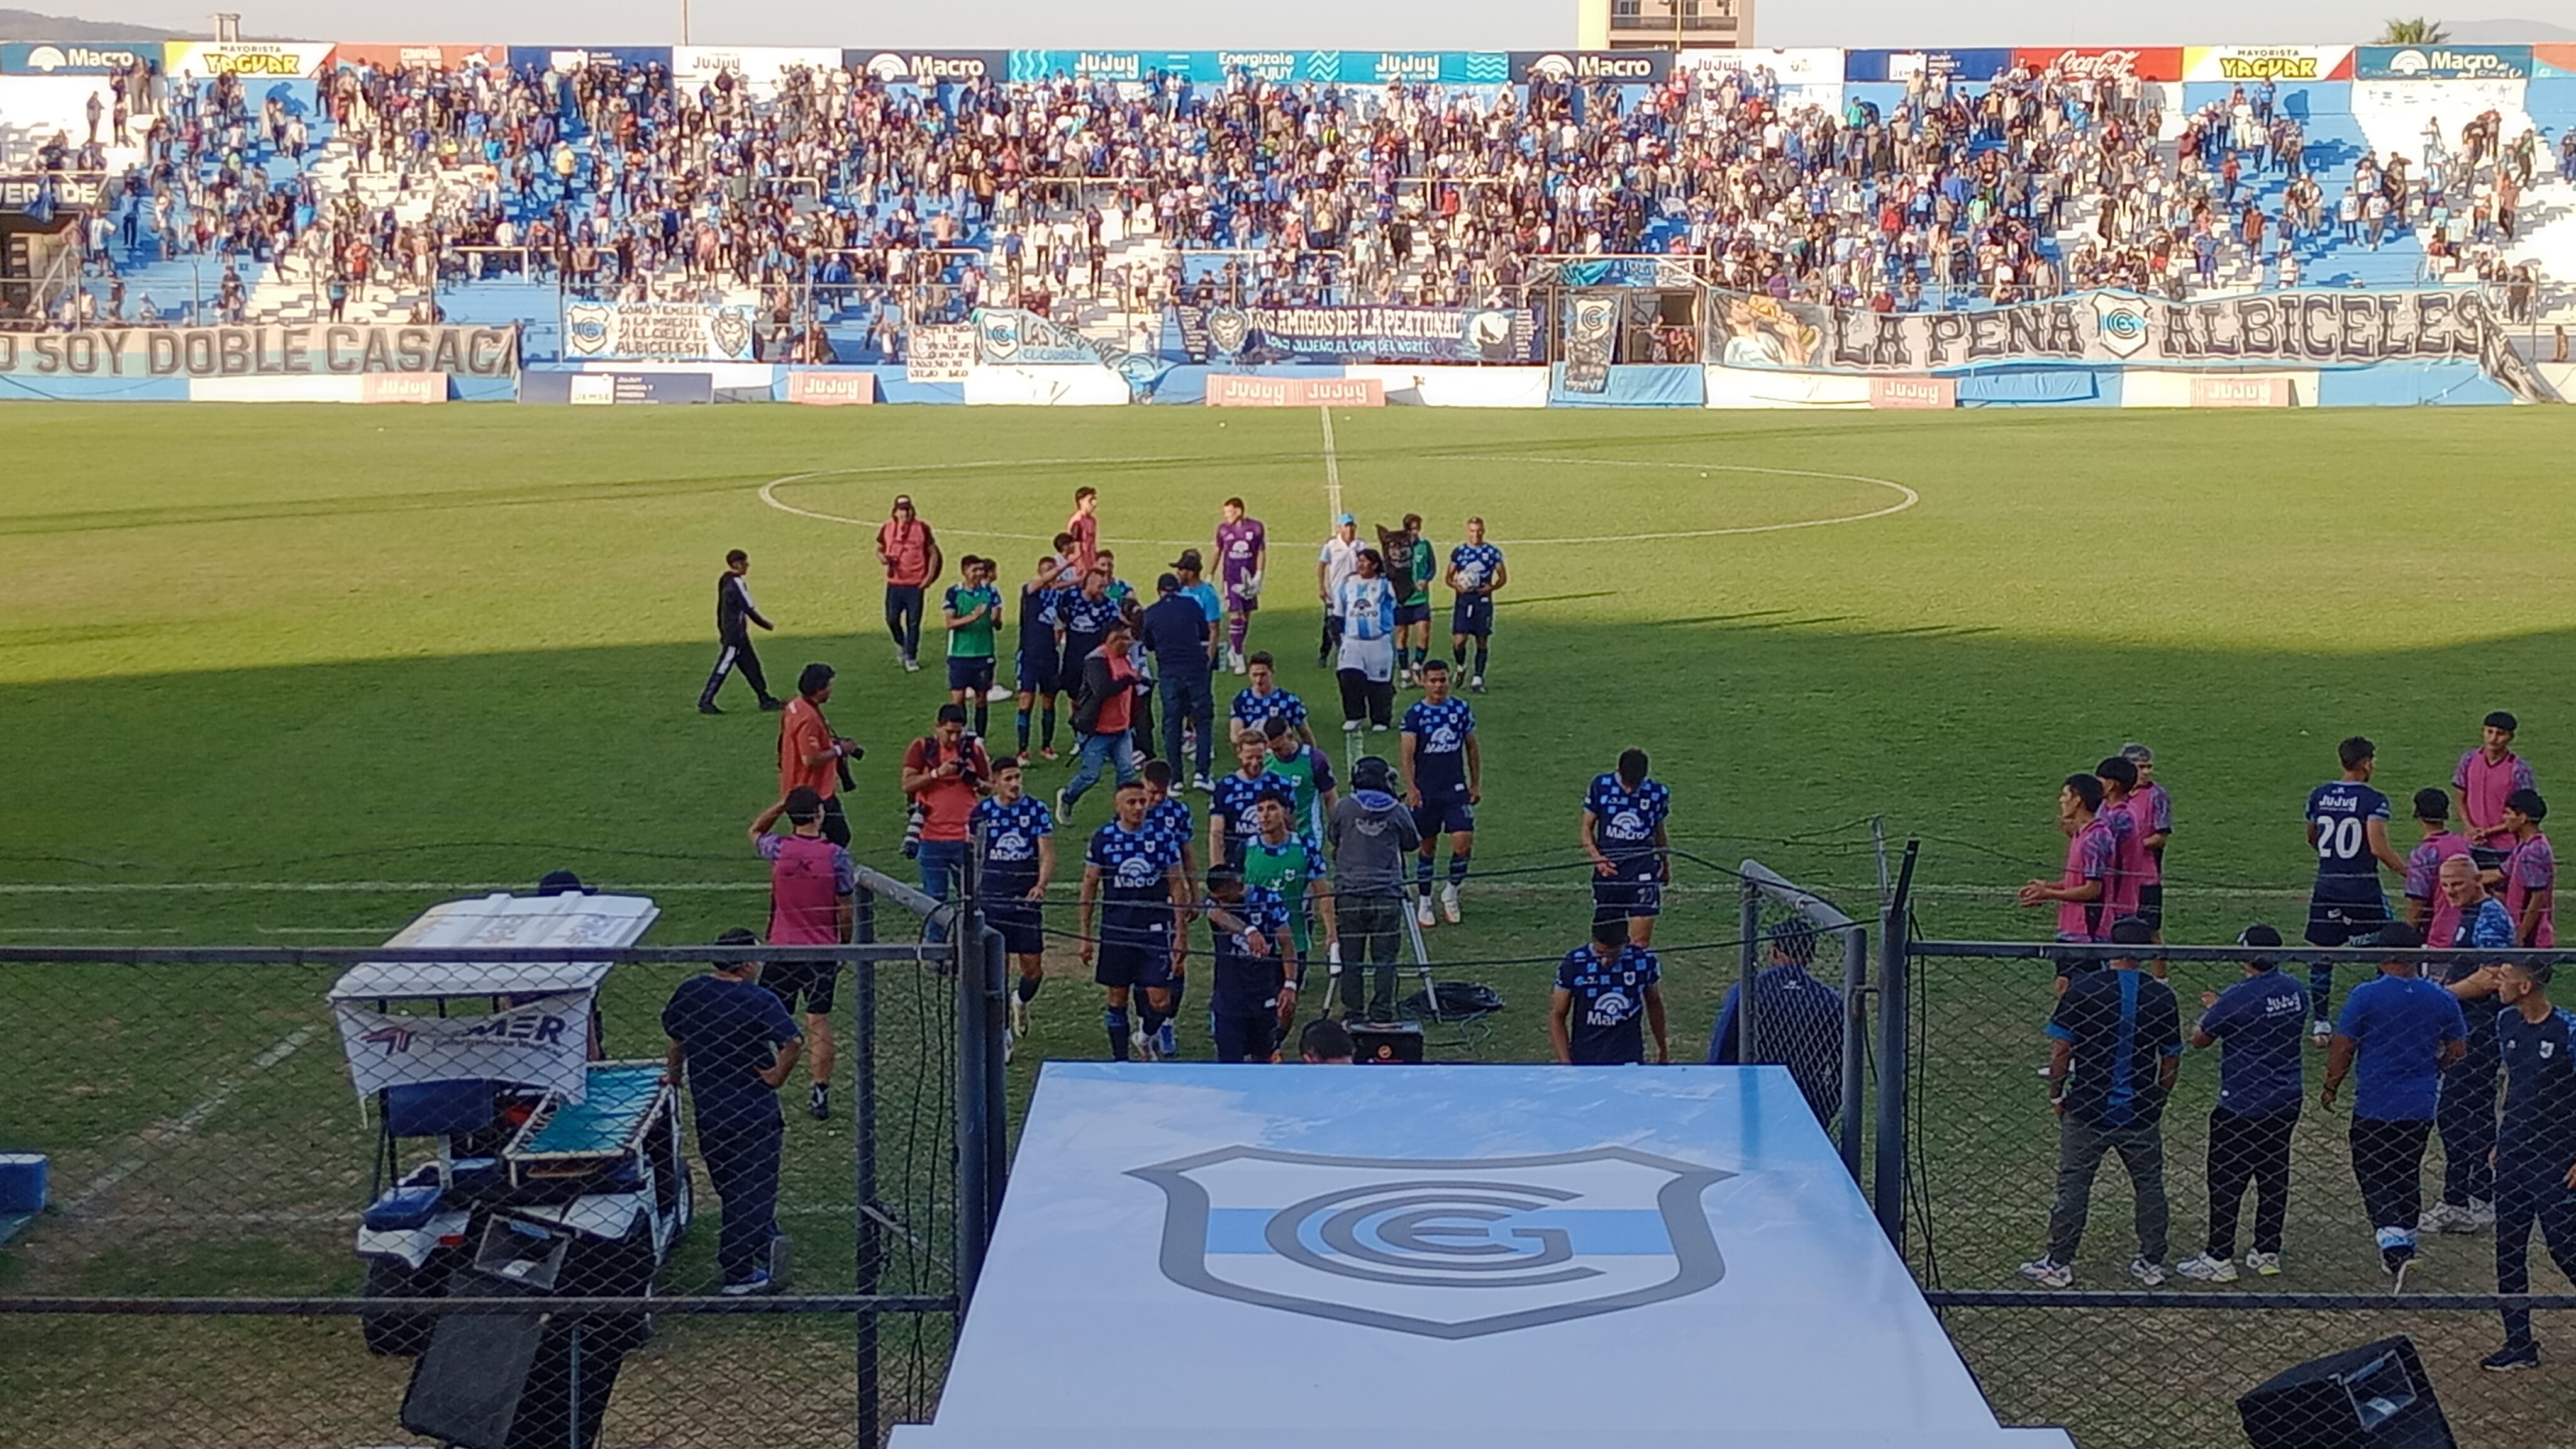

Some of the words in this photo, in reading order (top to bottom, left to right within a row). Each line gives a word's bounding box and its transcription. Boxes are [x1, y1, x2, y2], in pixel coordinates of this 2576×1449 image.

[69, 48, 134, 67] Macro
[203, 53, 300, 74] YAGUAR
[911, 56, 985, 76] Macro
[1577, 56, 1652, 76] Macro
[2219, 58, 2317, 77] YAGUAR
[2431, 51, 2498, 69] Macro
[1277, 309, 1335, 336] AMIGOS
[1336, 310, 1358, 336] DE
[1360, 308, 1383, 335] LA
[1383, 309, 1463, 339] PEATONAL
[614, 341, 709, 357] ALBICELESTE
[1835, 311, 1914, 367] LA
[33, 328, 131, 375] SOY
[148, 326, 312, 375] DOBLE
[1606, 825, 1652, 840] Macro
[2317, 815, 2363, 859] 20
[1113, 875, 1156, 889] Macro
